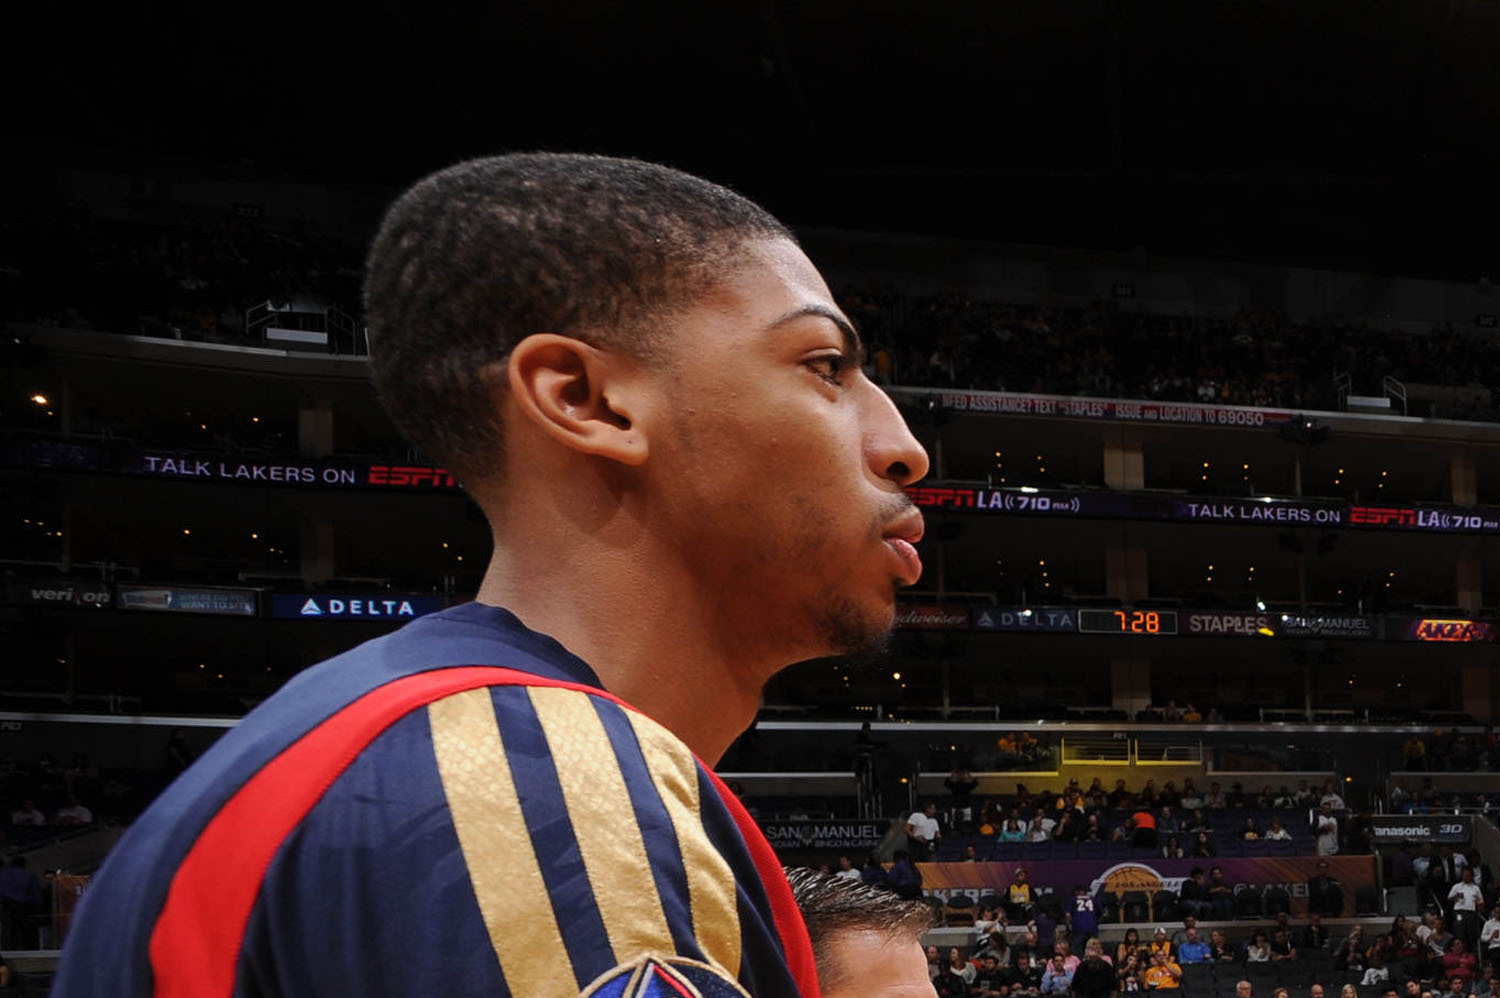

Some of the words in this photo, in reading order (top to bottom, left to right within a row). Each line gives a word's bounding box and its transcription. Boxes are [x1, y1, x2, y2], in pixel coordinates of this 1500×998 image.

[1035, 399, 1056, 414] TEXT
[1115, 404, 1142, 419] ISSUE
[1159, 406, 1201, 422] LOCATION
[1204, 409, 1216, 423] TO
[1218, 410, 1265, 426] 69050
[144, 456, 211, 476] TALK
[220, 463, 316, 483] LAKERS
[322, 468, 355, 485] ON
[367, 465, 455, 487] ESPN
[977, 491, 1003, 509] LA
[1188, 503, 1235, 519] TALK
[1240, 506, 1311, 521] LAKERS
[1316, 509, 1341, 523] ON
[1350, 507, 1415, 525] ESPN
[1417, 510, 1440, 527] LA
[328, 600, 415, 616] DELTA
[1001, 612, 1073, 627] DELTA
[1189, 614, 1269, 633] STAPLES
[766, 825, 802, 840] SAN
[814, 824, 881, 840] MANUEL
[1076, 899, 1094, 912] 24
